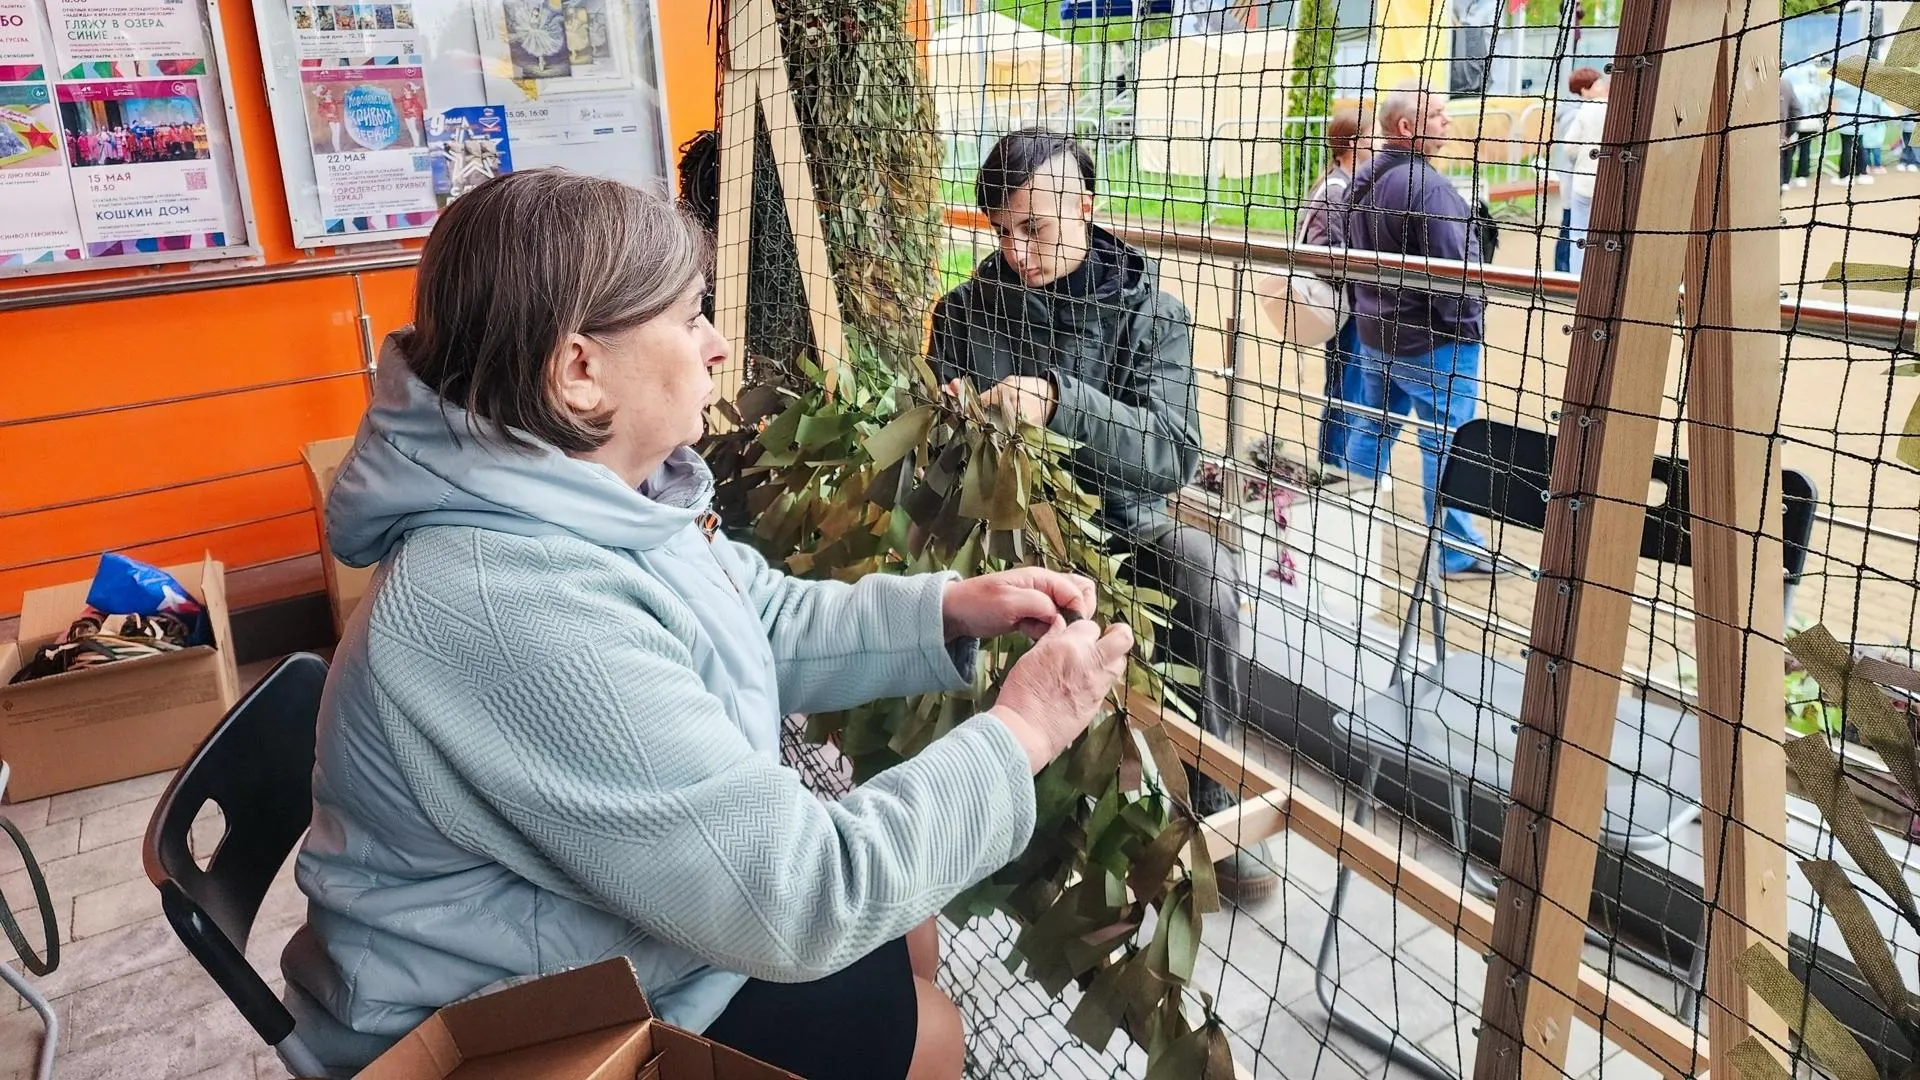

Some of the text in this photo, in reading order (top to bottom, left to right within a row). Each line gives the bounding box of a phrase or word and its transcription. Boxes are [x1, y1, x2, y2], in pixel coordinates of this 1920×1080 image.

[64, 18, 165, 29] ГЛЯЖУ В ОЗЕРА
[67, 30, 108, 41] СИНИЕ
[326, 153, 366, 164] 22 МАЯ
[328, 164, 351, 172] 18.00
[88, 172, 131, 183] 15 МАЯ
[96, 206, 190, 220] КОШКИН ДОМ
